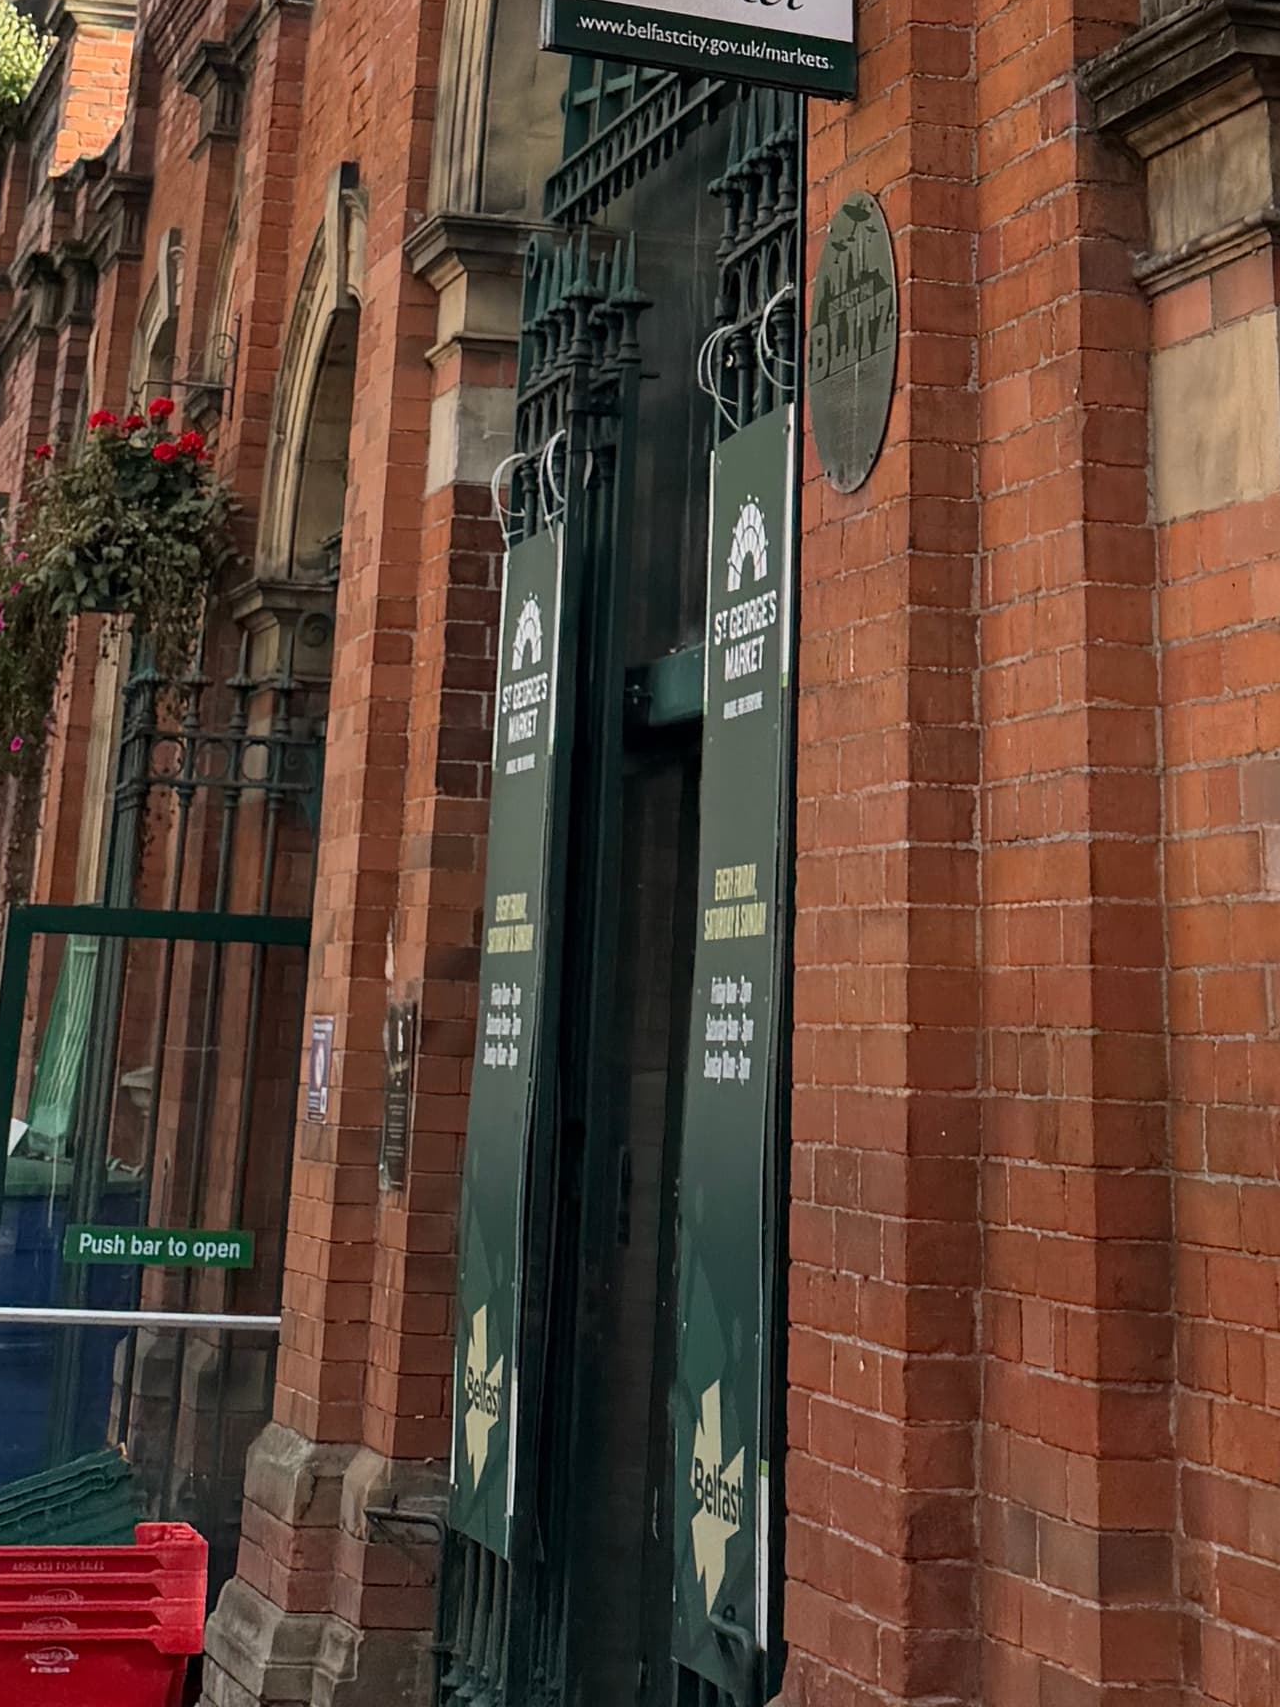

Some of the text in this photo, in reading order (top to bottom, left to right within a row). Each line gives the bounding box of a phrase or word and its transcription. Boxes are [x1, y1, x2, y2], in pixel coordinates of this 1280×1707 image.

[809, 287, 893, 384] BLITZ
[729, 589, 777, 640] GEORGE'S
[724, 635, 765, 682] MARKET
[79, 1233, 241, 1262] Push bar to open
[466, 1366, 501, 1418] Belfast
[693, 1458, 745, 1525] Belfast
